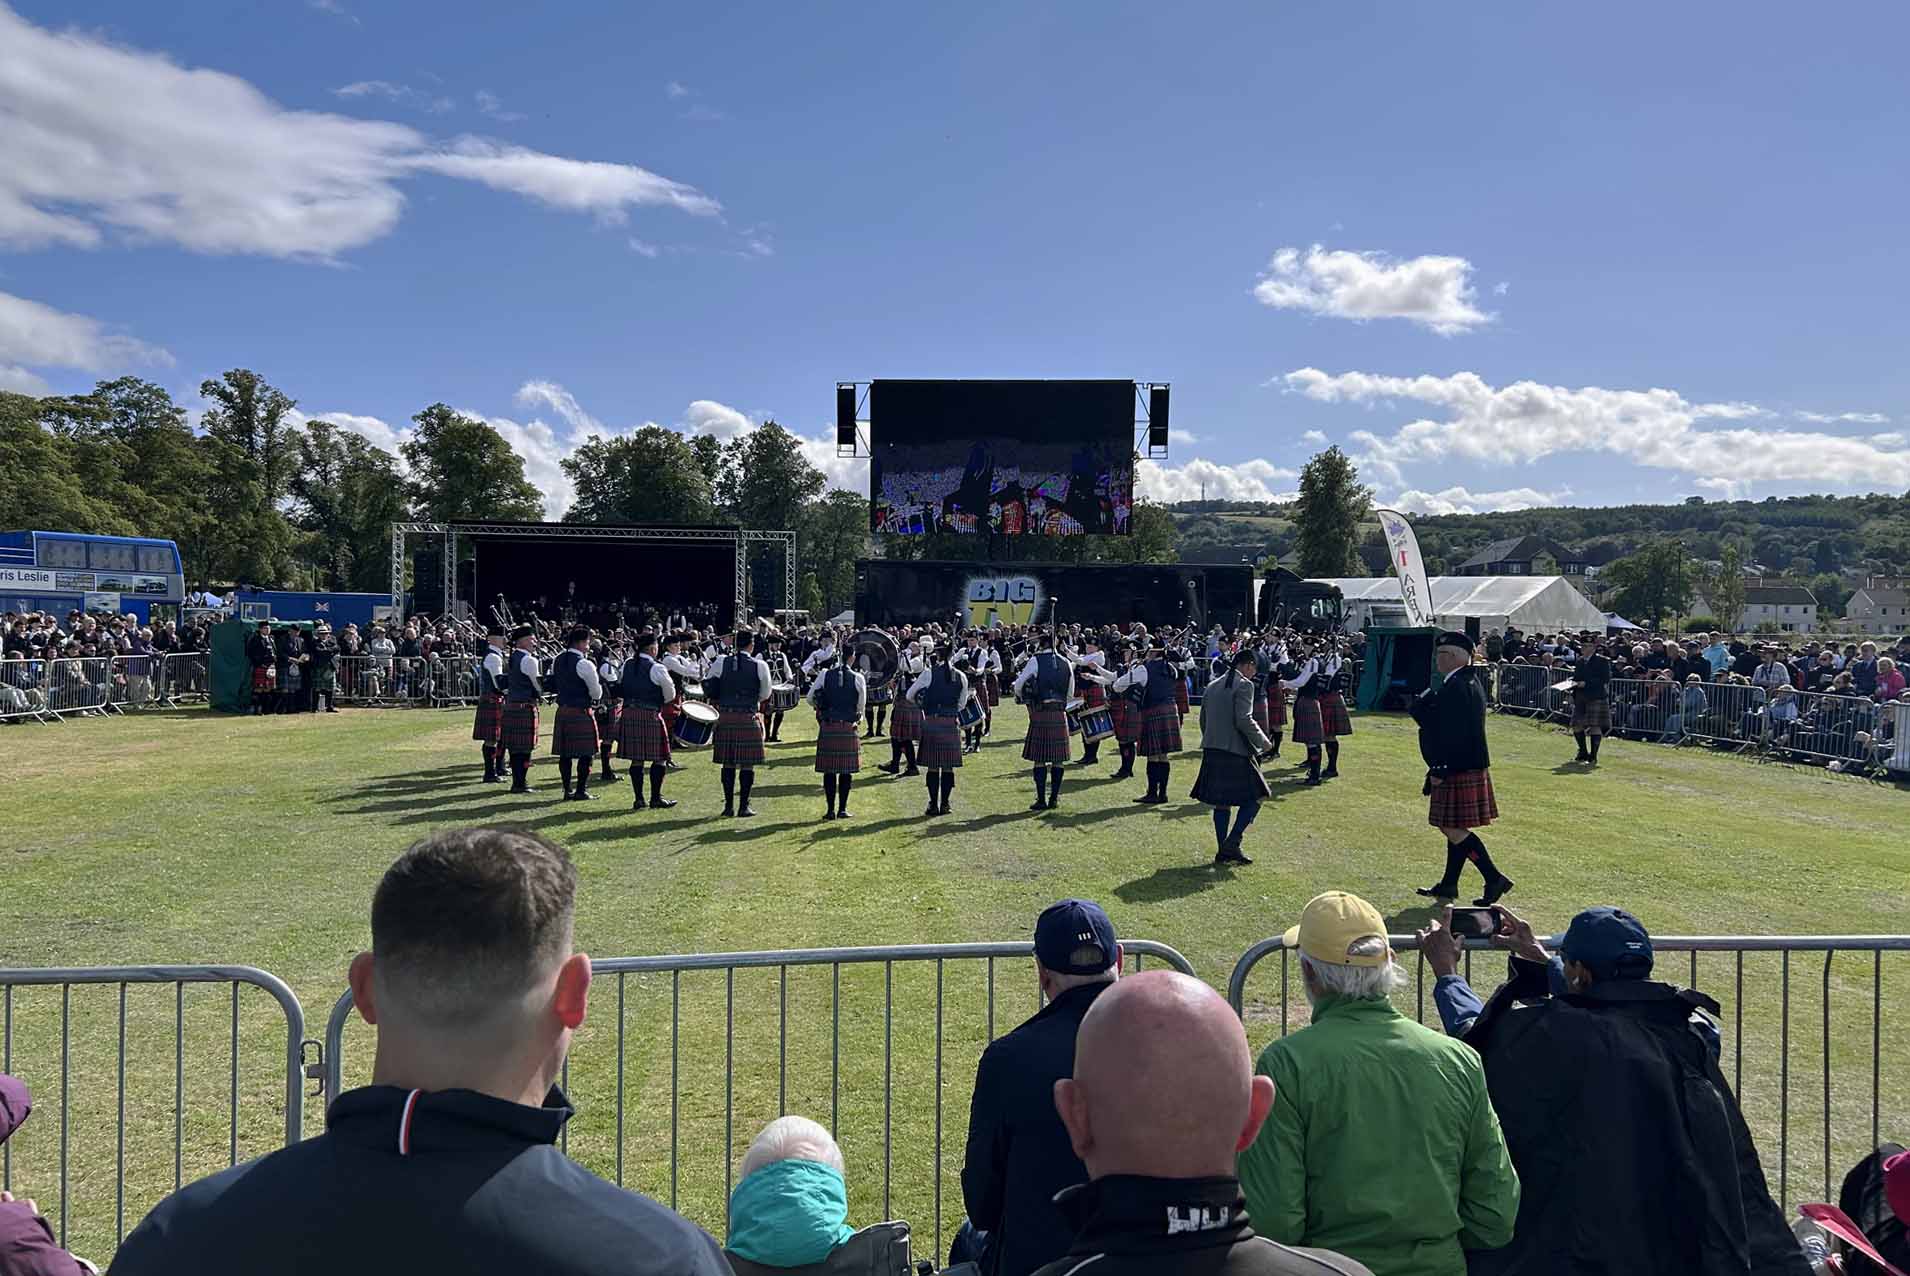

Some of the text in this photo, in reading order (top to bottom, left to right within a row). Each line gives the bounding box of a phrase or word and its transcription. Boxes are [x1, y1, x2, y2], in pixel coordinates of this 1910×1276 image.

[17, 571, 49, 582] Leslie
[969, 579, 1035, 603] BIG
[968, 602, 1034, 628] TV
